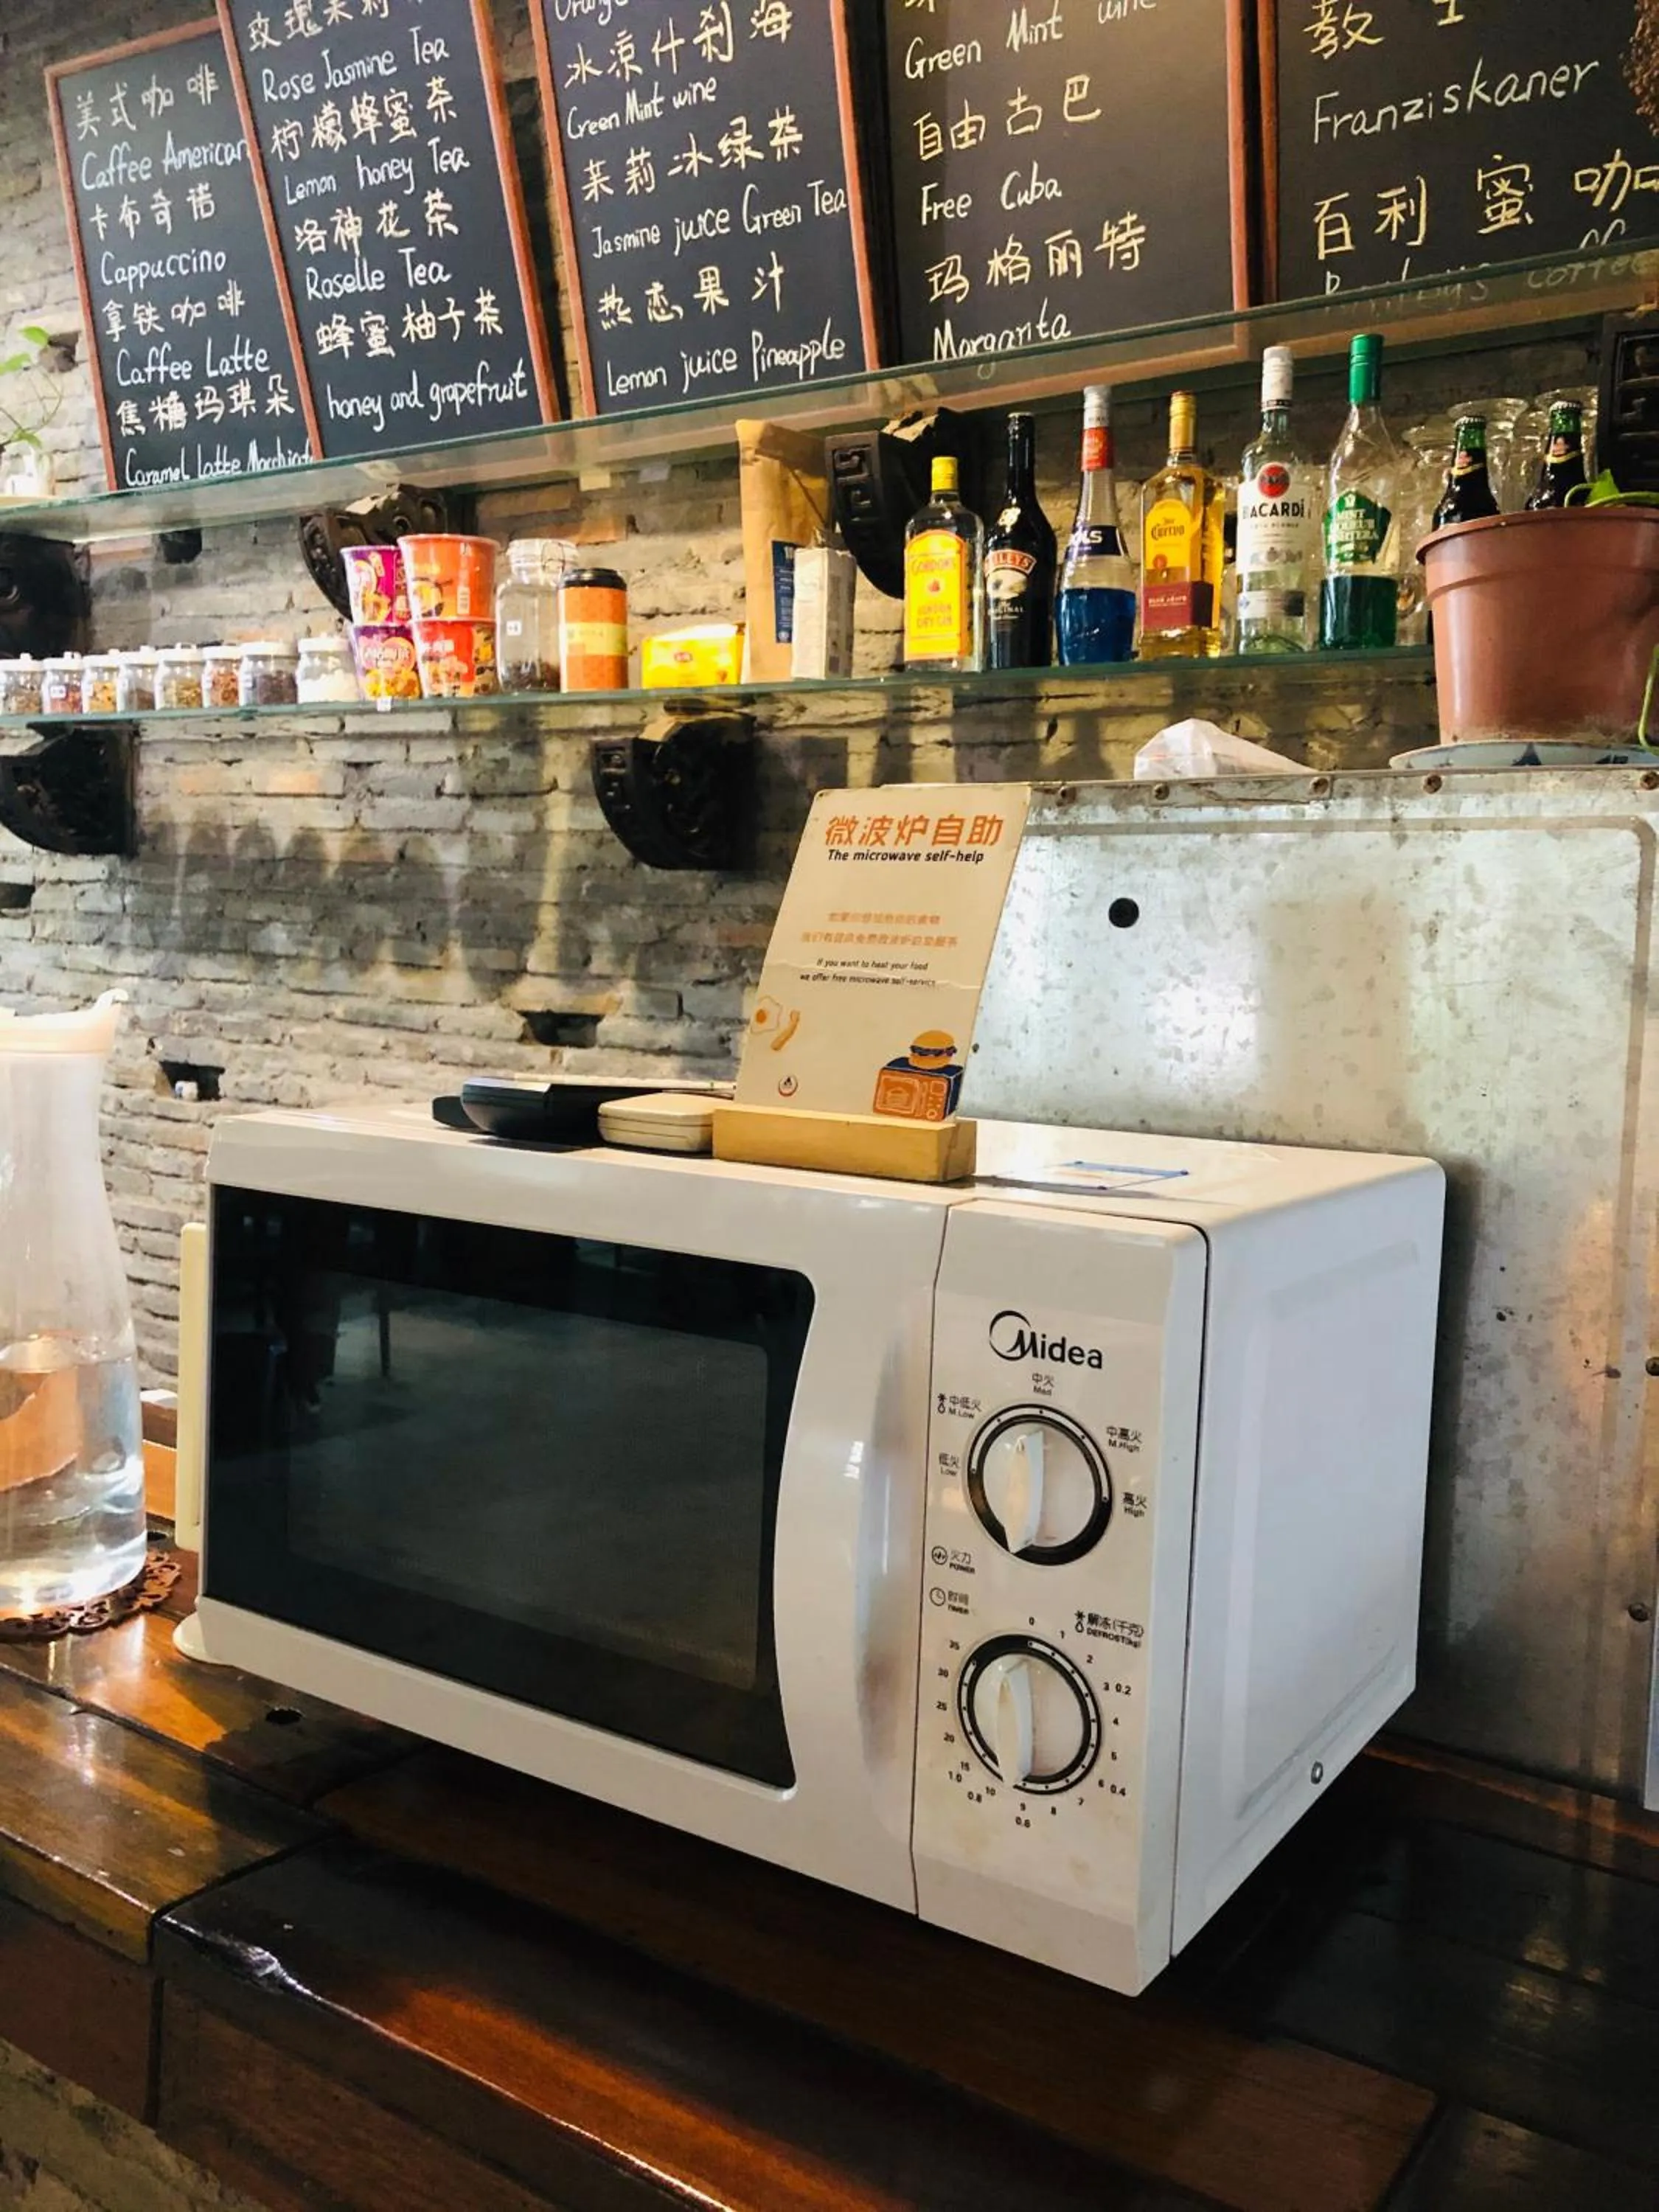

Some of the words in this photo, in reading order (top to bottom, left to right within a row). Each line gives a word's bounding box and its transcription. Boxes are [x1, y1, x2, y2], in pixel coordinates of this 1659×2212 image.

[262, 69, 316, 102] Rose
[321, 49, 397, 89] Jasmine
[409, 26, 449, 65] Tea
[905, 37, 981, 79] Green
[1006, 0, 1063, 53] Mint
[77, 63, 219, 141] 美式咖啡
[271, 75, 456, 162] 柠檬蜂蜜茶
[567, 106, 619, 140] Green
[625, 81, 664, 125] Mint
[672, 77, 717, 110] wine
[914, 74, 1102, 161] 自由古巴
[1314, 58, 1599, 145] Franziskaner
[285, 175, 337, 206] Lemon
[356, 155, 415, 195] honey
[428, 136, 470, 175] Tea
[582, 105, 804, 203] 茉莉冰绿茶
[89, 182, 215, 240] 卡布奇诺
[922, 182, 972, 225] Free
[1000, 161, 1062, 210] Cuba
[294, 187, 459, 257] 洛神花茶
[591, 223, 661, 259] Jasmine
[673, 208, 730, 256] juice
[742, 184, 801, 236] Green
[807, 179, 846, 217] Tea
[101, 248, 226, 294] Cappuccino
[306, 257, 385, 301] Roselle
[398, 247, 452, 288] Tea
[925, 211, 1146, 303] 玛格丽特
[102, 279, 245, 342] 拿铁咖啡
[598, 251, 784, 331] 热恋果汁
[316, 286, 503, 360] 蜂蜜柚子茶
[933, 297, 1071, 369] Margarita
[206, 334, 270, 378] Latte
[607, 361, 667, 397] Lemon
[683, 344, 737, 393] juice
[751, 316, 846, 383] Pineapple
[116, 373, 295, 437] 焦糖玛琪朵
[327, 383, 386, 432] honey
[391, 369, 425, 411] and
[429, 357, 527, 422] grapefruit
[125, 446, 190, 487] Caramel
[825, 814, 1004, 846] 微波炉自助
[827, 849, 849, 861] The
[853, 849, 921, 862] microwave
[925, 849, 984, 865] self-help
[824, 959, 838, 967] you
[872, 960, 889, 969] heat
[890, 963, 909, 971] your
[832, 973, 847, 983] free
[849, 975, 890, 985] microwave
[990, 1310, 1103, 1369] Midea
[949, 1396, 982, 1412] 中低火
[1032, 1373, 1054, 1388] 中火
[940, 1467, 957, 1476] Low
[950, 1550, 971, 1565] 火力
[1029, 1617, 1035, 1625] 0
[1060, 1630, 1065, 1639] 1
[1086, 1654, 1093, 1664] 2
[936, 1701, 947, 1711] 25
[1115, 1683, 1132, 1696] 0.2
[943, 1732, 955, 1743] 20
[1113, 1717, 1119, 1726] 4
[948, 1770, 962, 1783] 1.0
[960, 1761, 970, 1772] 15
[986, 1786, 996, 1797] 10
[1110, 1784, 1127, 1797] 0.4
[967, 1791, 982, 1804] 0.8
